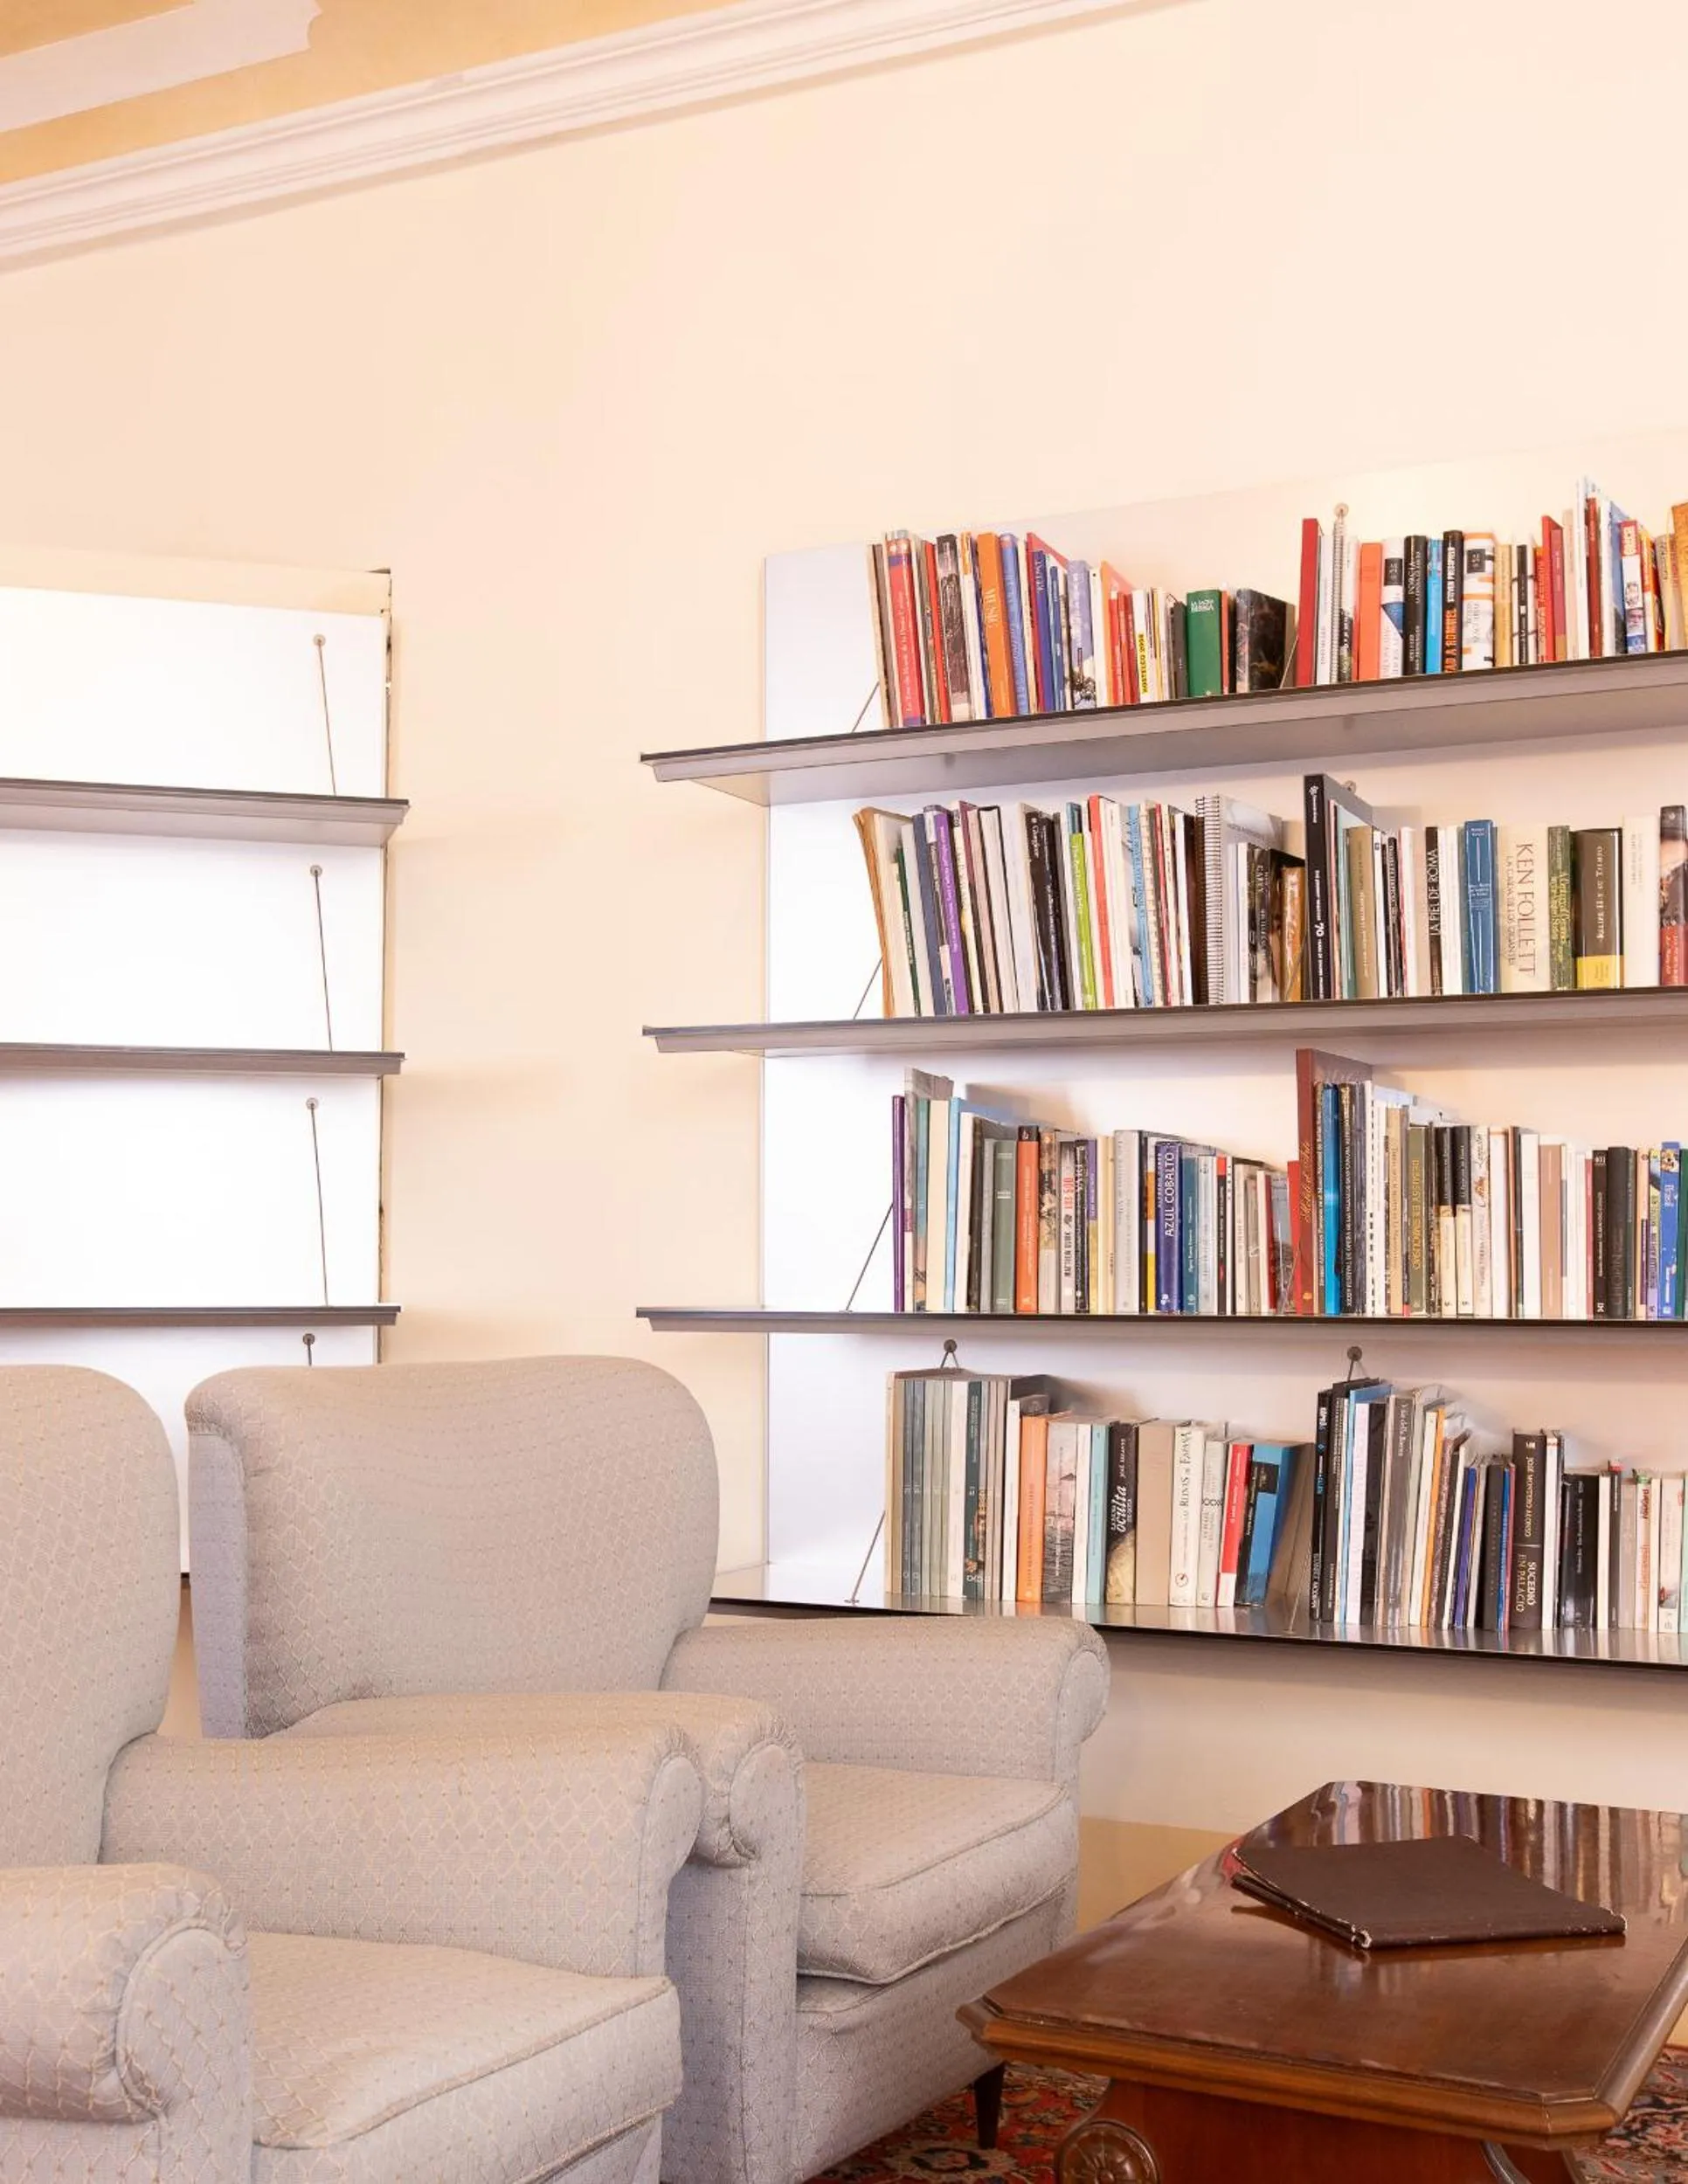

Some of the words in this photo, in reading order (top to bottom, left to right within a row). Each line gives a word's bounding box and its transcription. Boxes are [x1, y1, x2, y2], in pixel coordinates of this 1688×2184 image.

[1138, 653, 1148, 694] HOSTELCO
[1426, 848, 1439, 882] ROMA
[1516, 843, 1534, 884] KEN
[1428, 886, 1440, 899] DE
[1314, 922, 1325, 937] 70
[1429, 923, 1441, 936] LA
[1517, 892, 1536, 977] FOLLETT
[1165, 1151, 1176, 1204] COBALTO
[1164, 1206, 1175, 1237] AZUL
[1114, 1485, 1128, 1533] oculta
[1180, 1476, 1190, 1507] REINAS
[1525, 1474, 1534, 1509] MONTERO
[1519, 1554, 1527, 1568] EN
[1516, 1569, 1526, 1613] PALACIO
[1526, 1561, 1538, 1606] SUCEDIÓ
